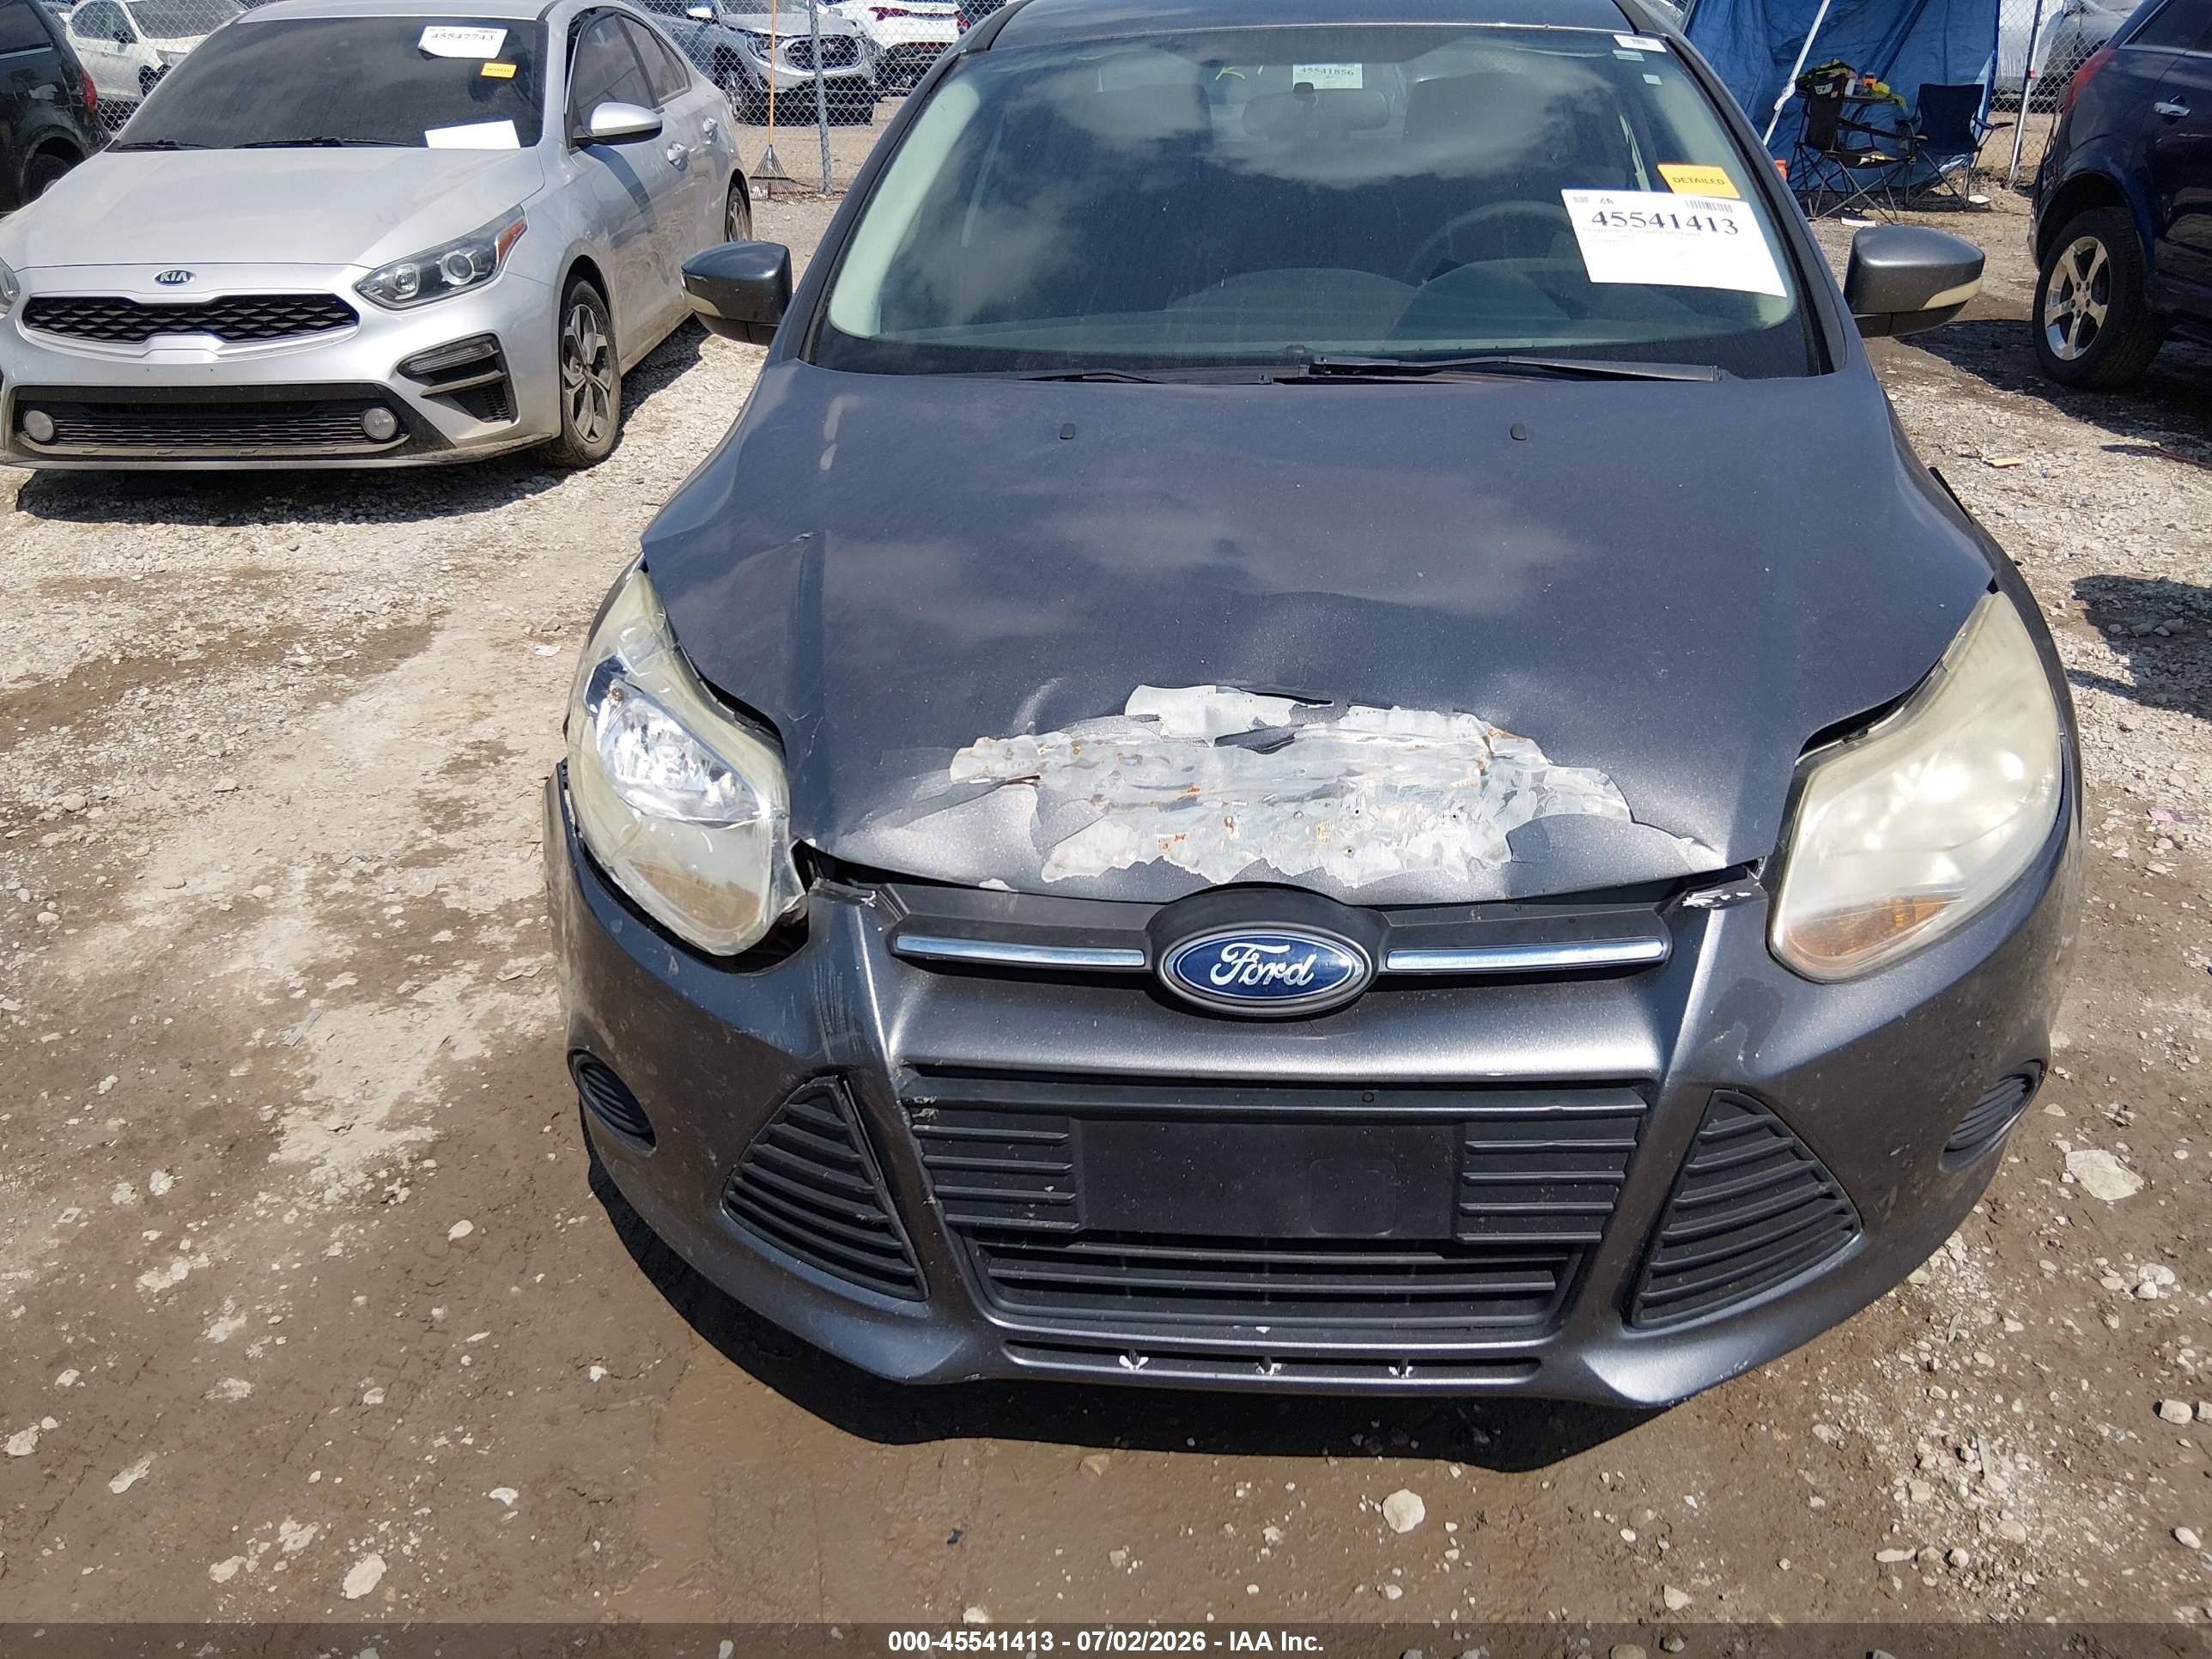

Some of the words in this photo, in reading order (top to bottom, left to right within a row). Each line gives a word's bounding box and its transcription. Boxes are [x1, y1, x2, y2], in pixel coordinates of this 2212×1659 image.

[1673, 177, 1725, 185] DETAILED
[1591, 211, 1739, 235] 45541413
[160, 271, 188, 282] KIA
[1210, 943, 1318, 986] Ford
